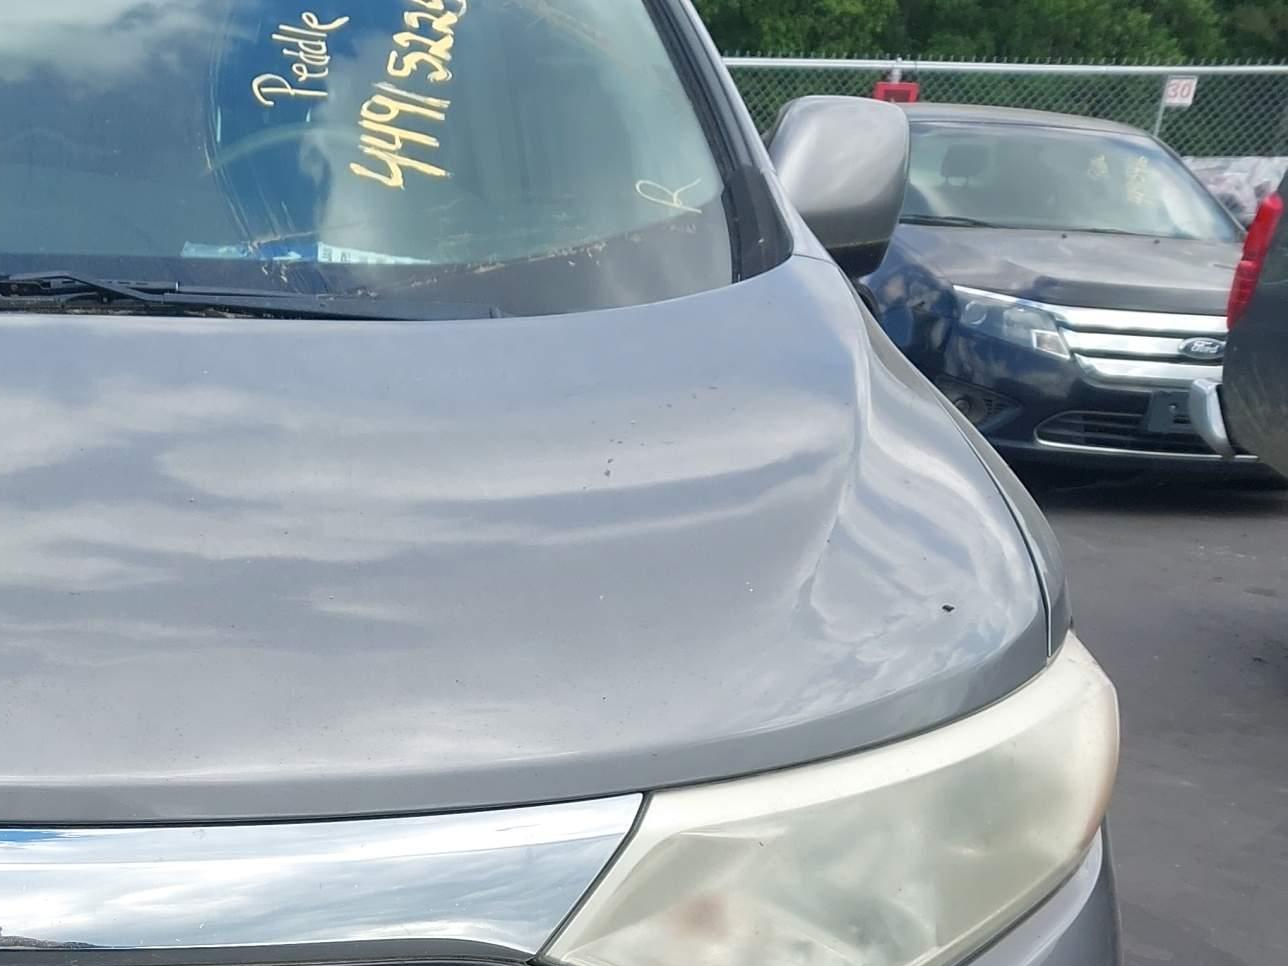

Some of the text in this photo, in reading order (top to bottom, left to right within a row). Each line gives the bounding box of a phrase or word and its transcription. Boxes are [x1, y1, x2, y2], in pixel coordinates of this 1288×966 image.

[252, 11, 350, 107] Peddle
[1166, 82, 1193, 99] 30
[1191, 340, 1221, 354] Ford
